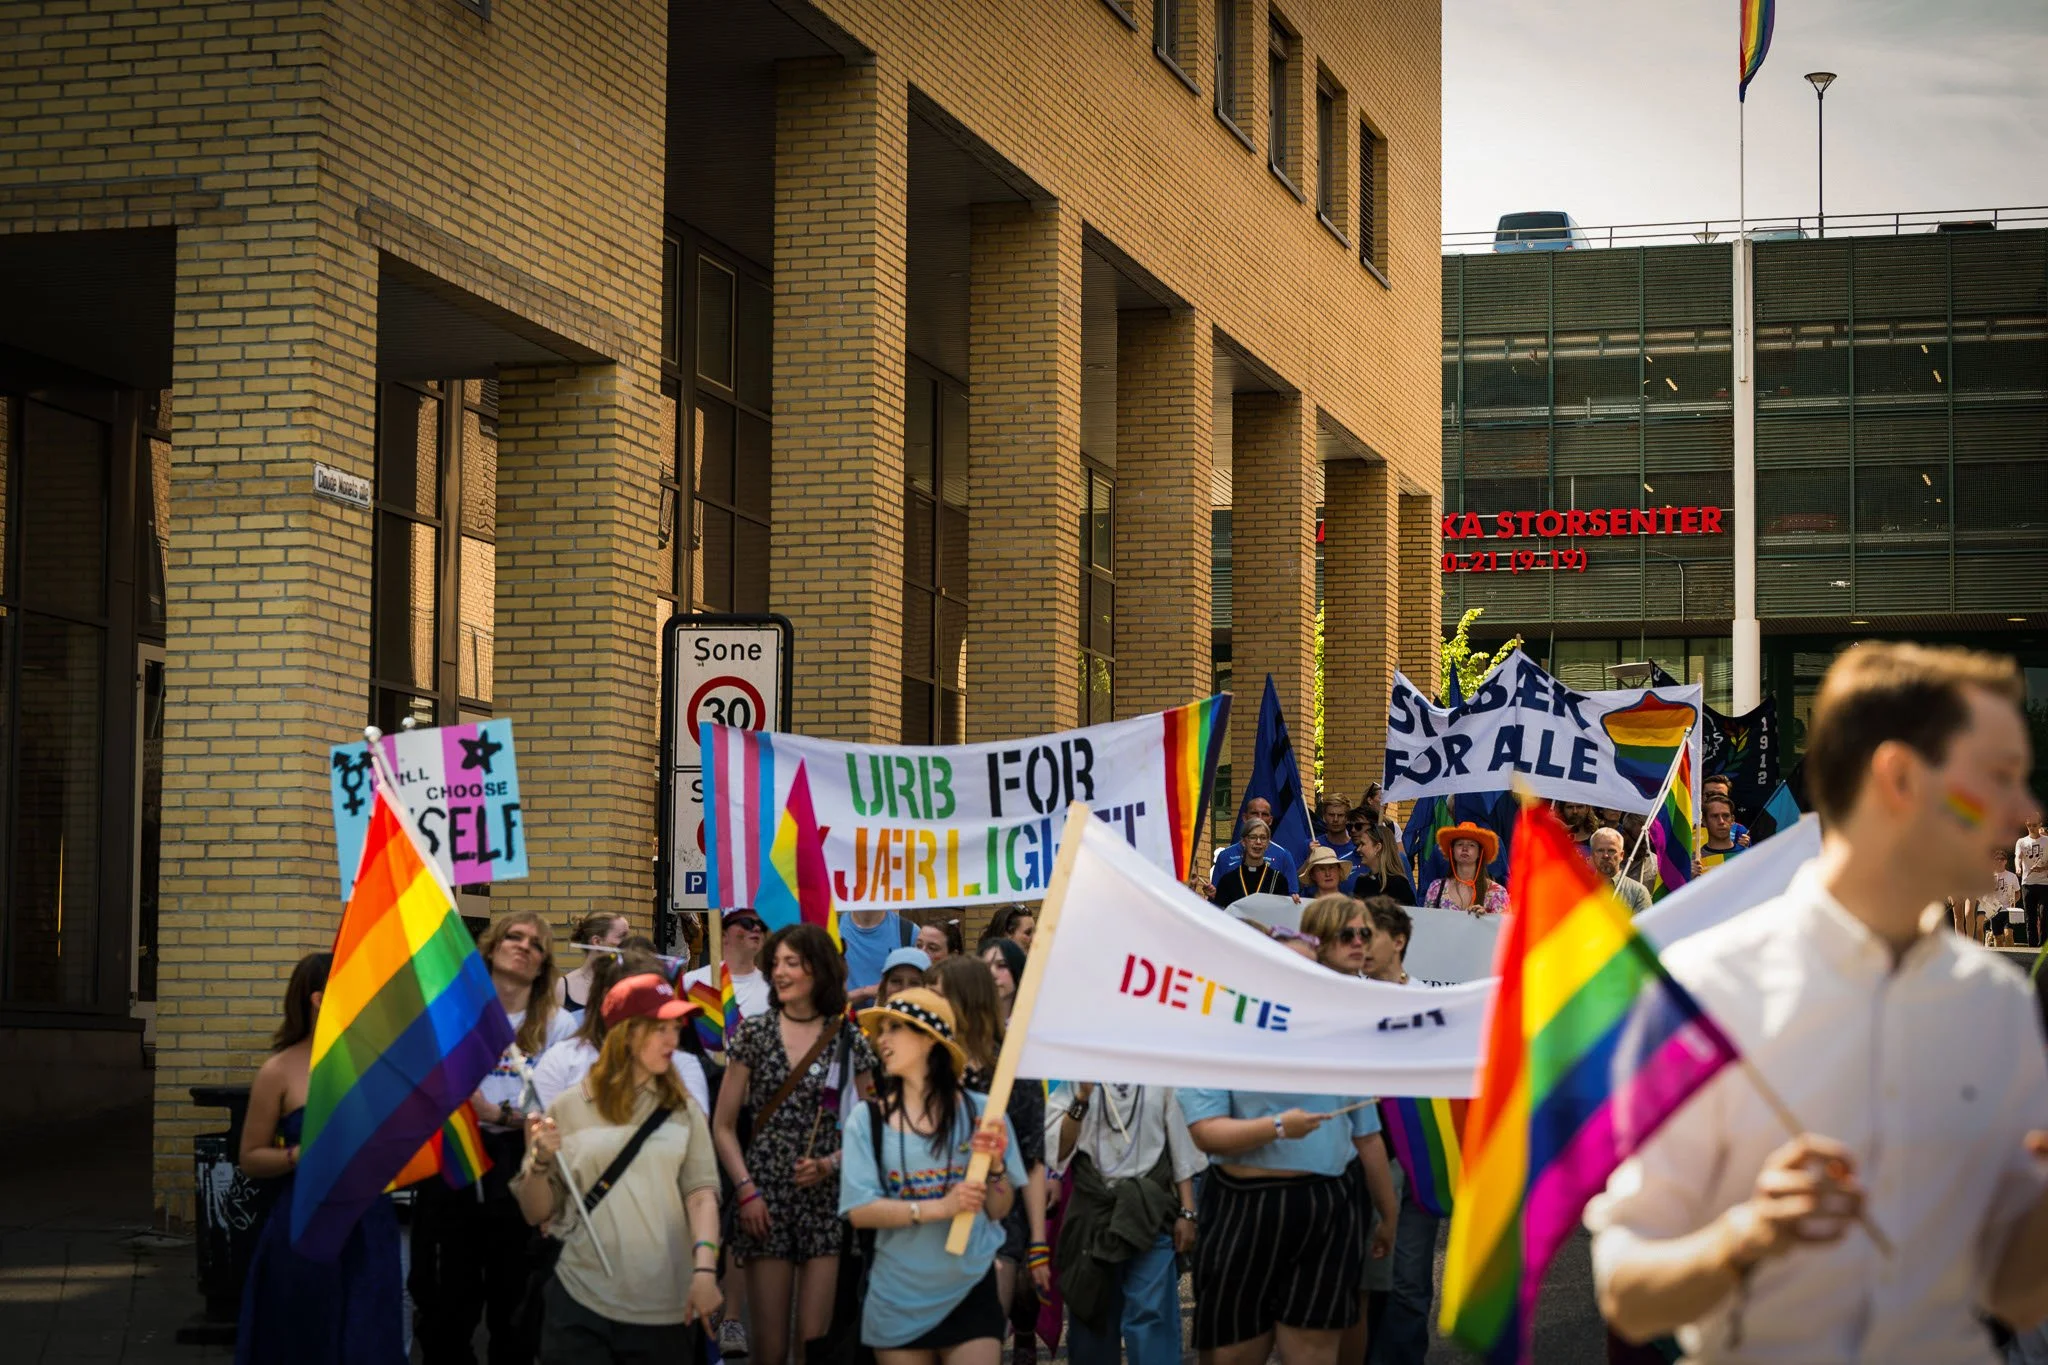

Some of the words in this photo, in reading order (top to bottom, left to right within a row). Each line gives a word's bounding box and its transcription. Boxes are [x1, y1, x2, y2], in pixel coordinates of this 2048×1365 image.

[1495, 505, 1723, 539] STORSENTER
[1441, 550, 1498, 574] 0-21
[1509, 546, 1588, 575] (9-19)
[694, 637, 762, 661] Sone
[702, 697, 751, 730] 30
[1384, 733, 1473, 791] FOR
[1487, 723, 1599, 784] ALLE
[426, 781, 508, 800] CHOOSE
[846, 752, 956, 819] URB
[987, 737, 1095, 818] FOR
[816, 801, 1146, 903] JÆRLIGT
[1119, 953, 1292, 1032] DETTE
